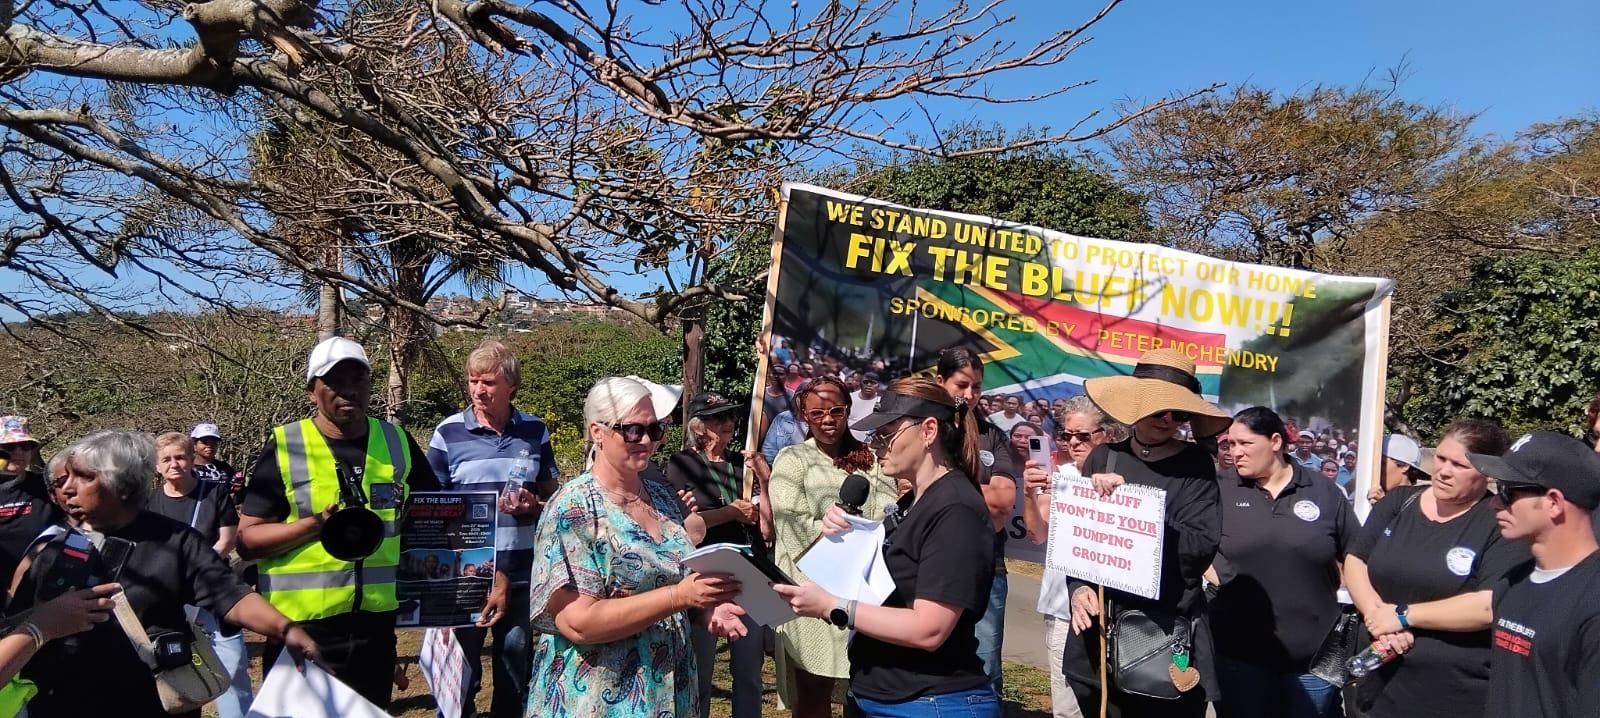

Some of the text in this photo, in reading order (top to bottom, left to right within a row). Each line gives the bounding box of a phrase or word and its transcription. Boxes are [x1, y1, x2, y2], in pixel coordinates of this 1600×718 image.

[826, 201, 1317, 299] WE STAND UNITED TO PROTECT OUR HOME
[846, 233, 1295, 338] FIX THE BLUFF NOW!!!
[890, 297, 1279, 373] SPONSORED BY PETER MCHENDRY
[1055, 502, 1157, 535] WON'T BE YOUR
[1072, 485, 1097, 500] THE
[1073, 525, 1134, 550] DUMPING
